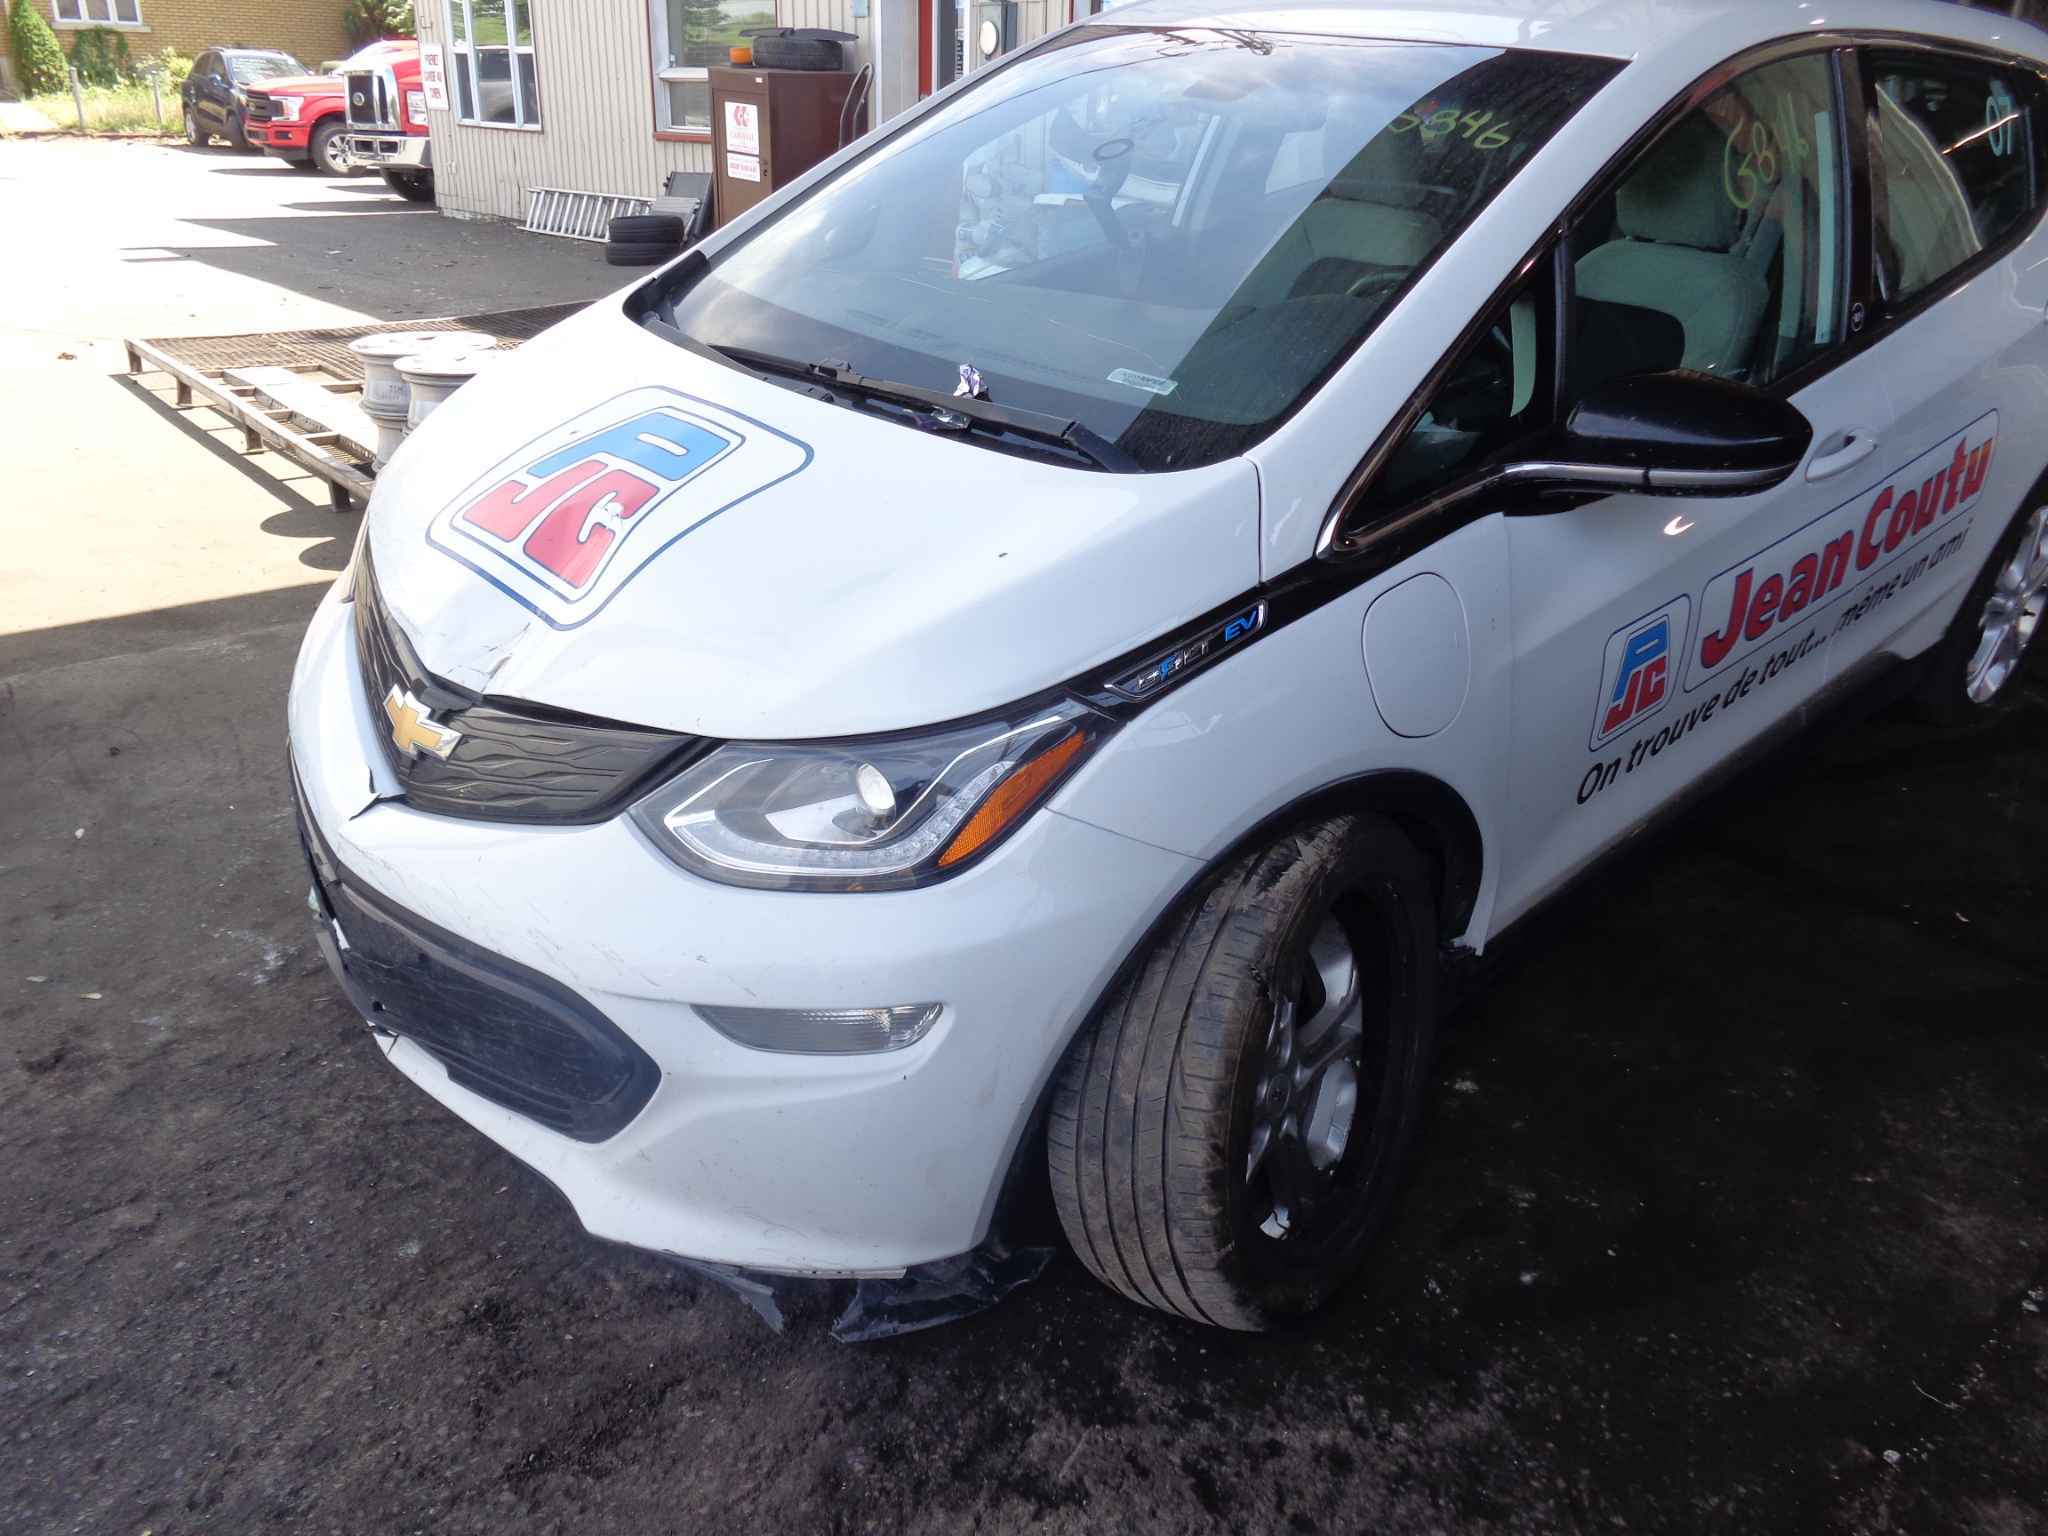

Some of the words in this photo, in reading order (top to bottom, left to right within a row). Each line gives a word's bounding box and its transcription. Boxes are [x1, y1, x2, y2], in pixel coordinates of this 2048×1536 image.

[1224, 608, 1258, 642] EV
[1576, 756, 1622, 805] On
[1625, 692, 1721, 774] trouve
[1721, 666, 1760, 710] de
[1900, 553, 1930, 590] un
[1927, 518, 1973, 571] ami
[1700, 566, 1855, 669] Jean
[1855, 435, 1993, 571] Coutu
